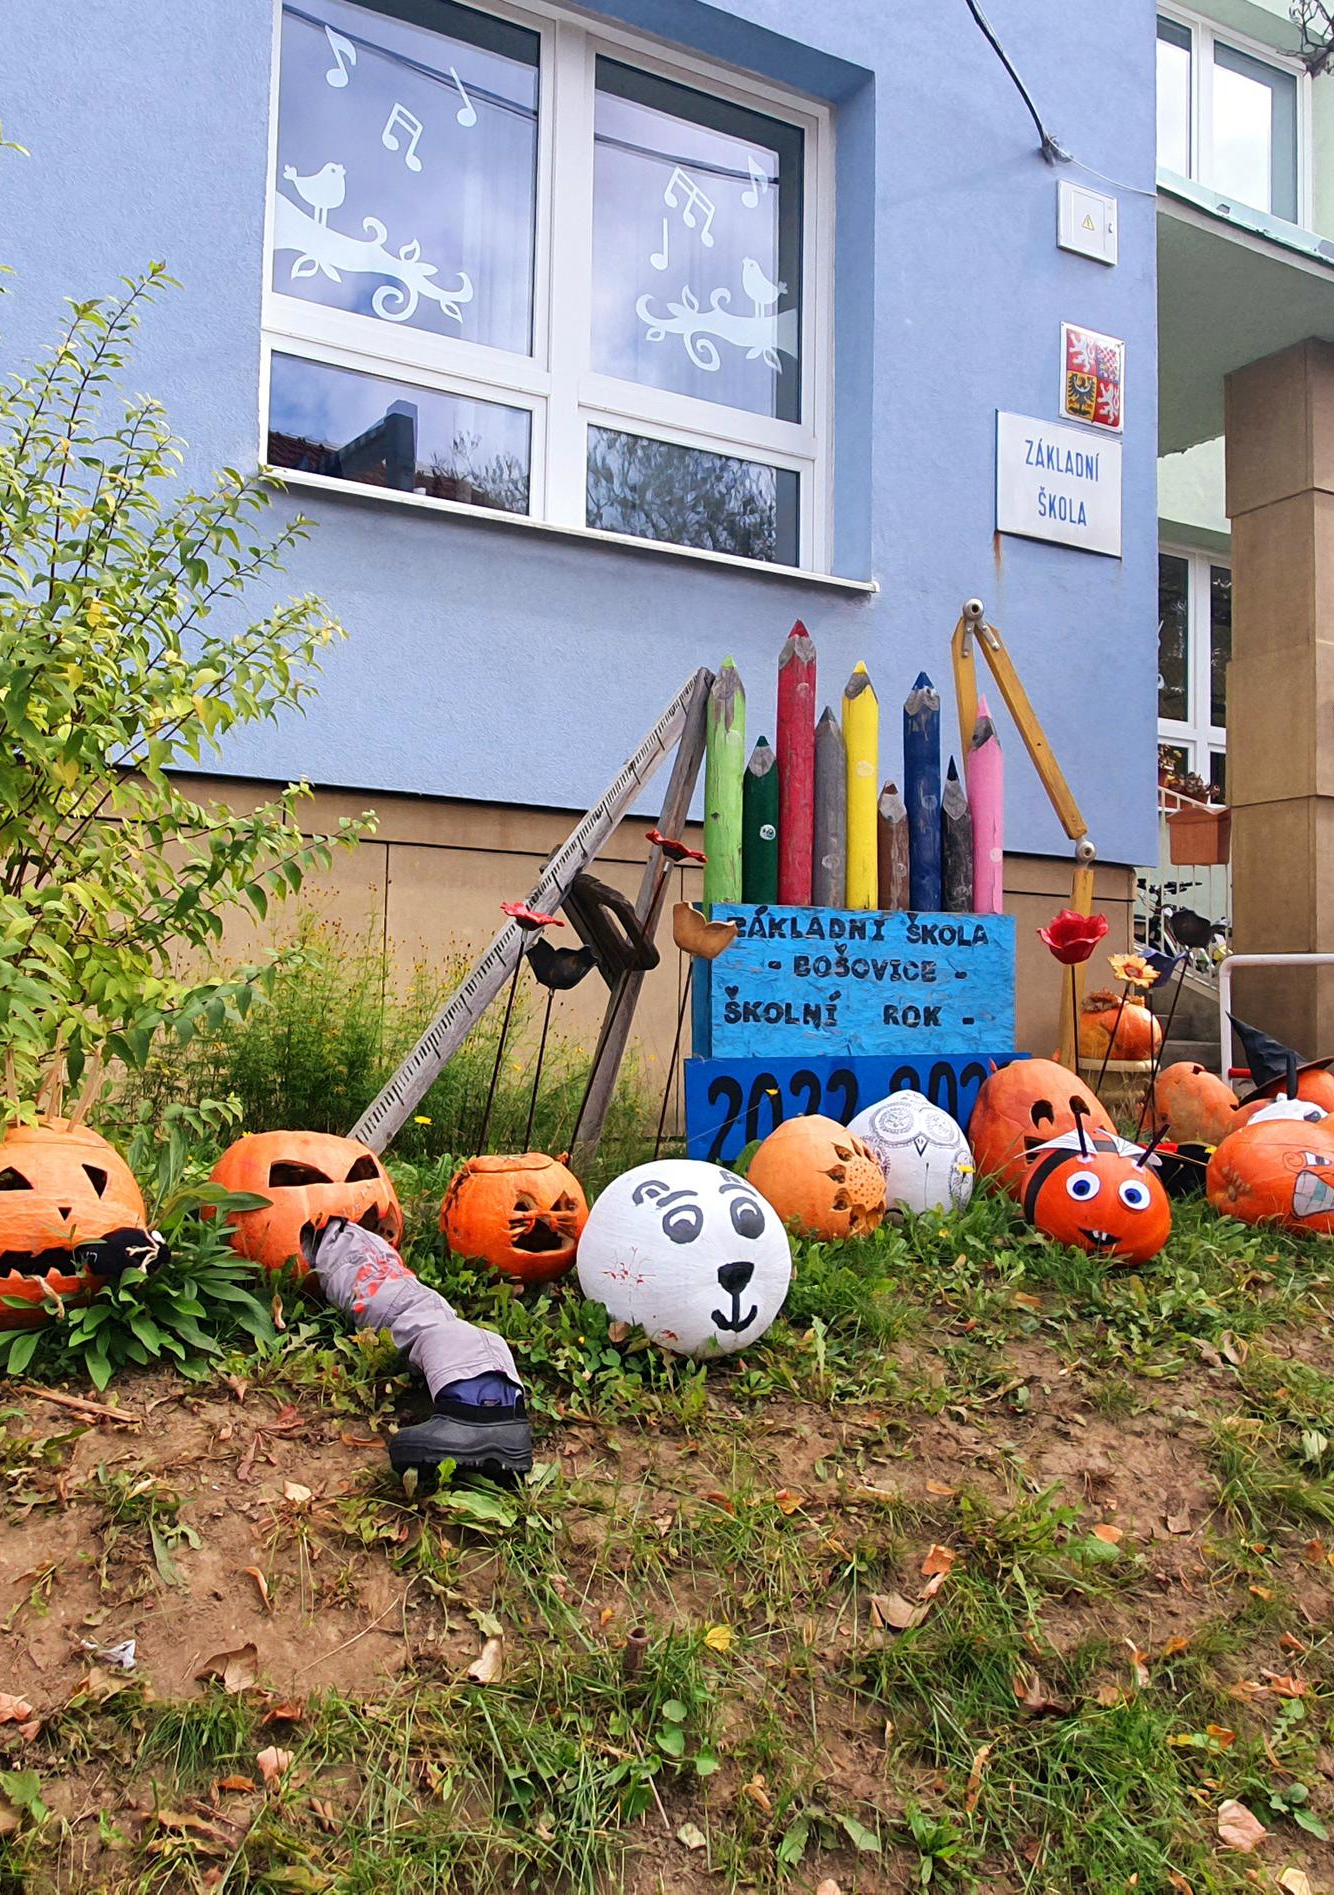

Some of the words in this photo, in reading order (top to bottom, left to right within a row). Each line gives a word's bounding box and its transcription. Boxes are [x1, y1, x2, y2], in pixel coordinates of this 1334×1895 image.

[1025, 438, 1100, 482] ZÁKLADNÍ
[1037, 485, 1087, 527] ŠKOLA
[905, 912, 990, 947] ŠKOLA
[792, 943, 938, 983] BOŠOVICE
[723, 985, 842, 1029] ŠKOLNÍ
[882, 1003, 942, 1029] ROK
